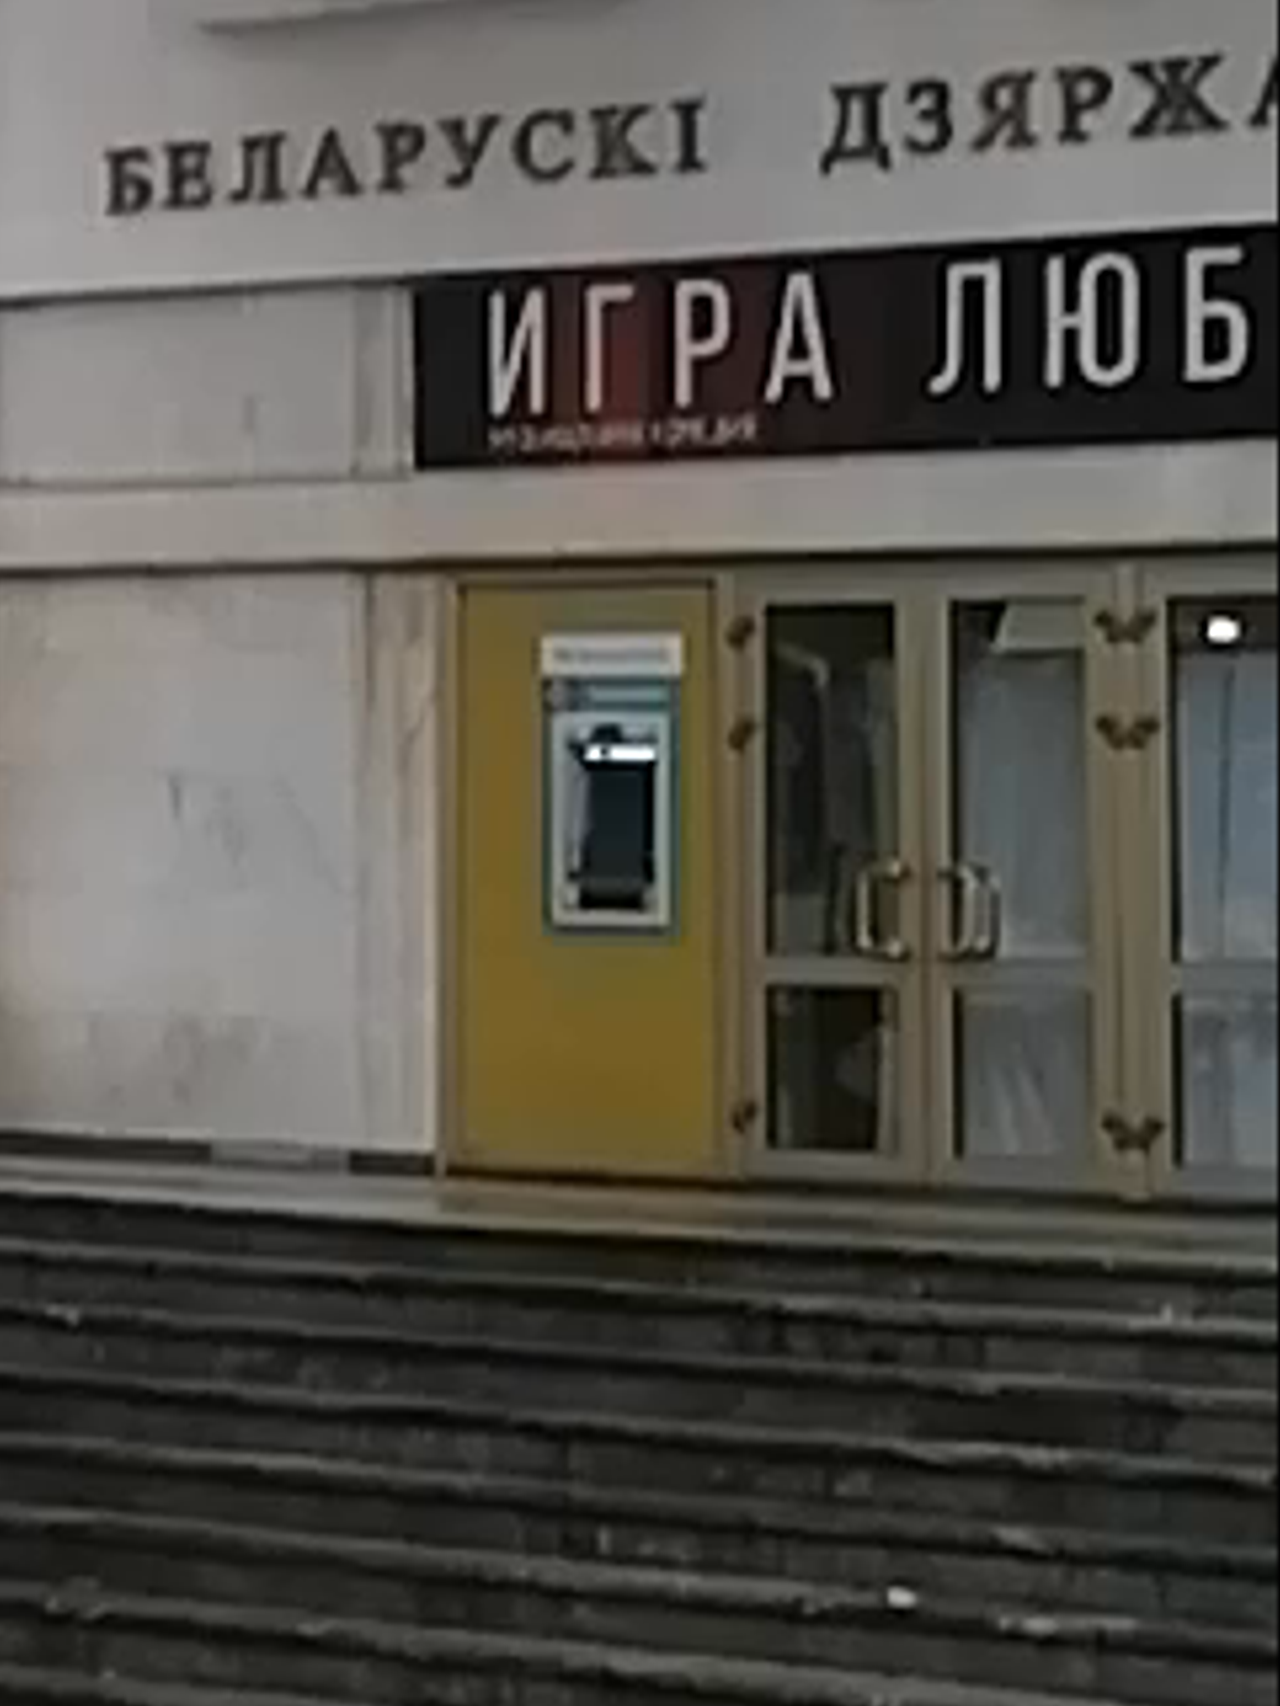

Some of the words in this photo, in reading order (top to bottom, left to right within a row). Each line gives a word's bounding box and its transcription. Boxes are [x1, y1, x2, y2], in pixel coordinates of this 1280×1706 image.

[104, 94, 707, 217] БЕЛАРУСКІ
[488, 271, 833, 417] ИГРА
[929, 246, 1248, 394] ЛЮБ
